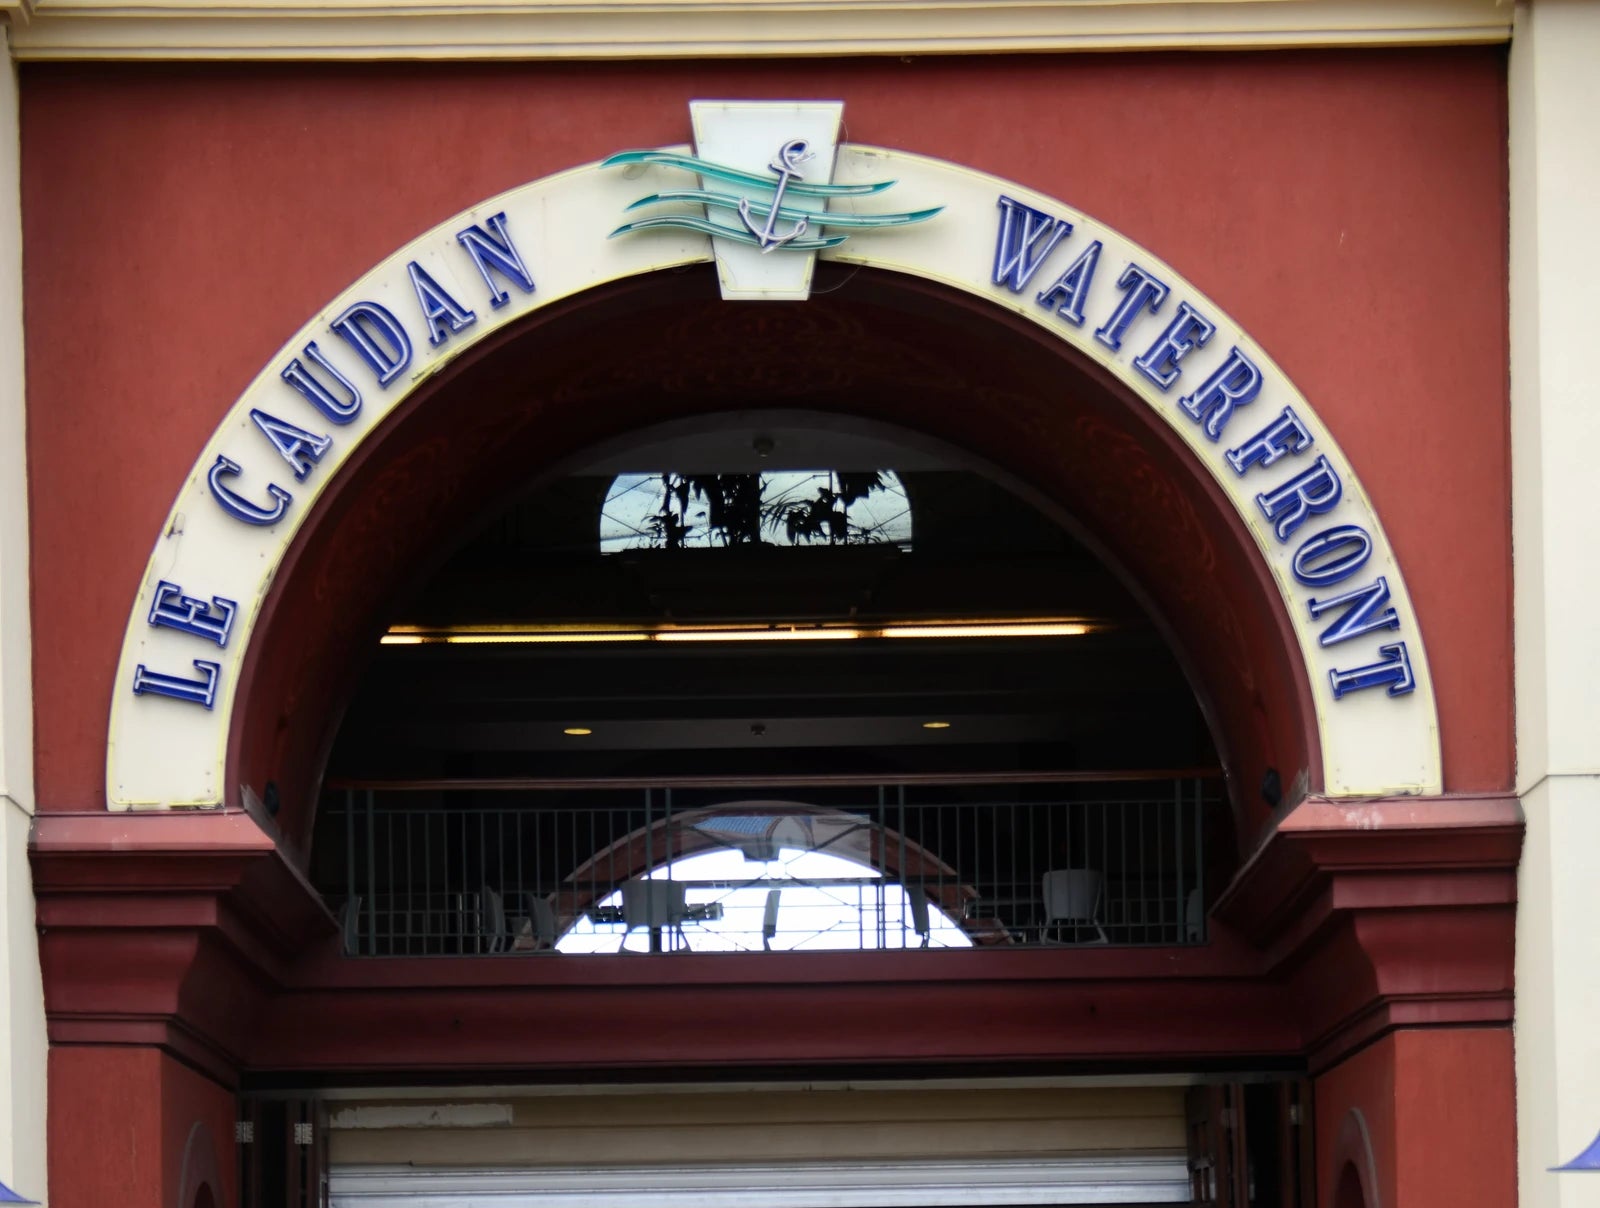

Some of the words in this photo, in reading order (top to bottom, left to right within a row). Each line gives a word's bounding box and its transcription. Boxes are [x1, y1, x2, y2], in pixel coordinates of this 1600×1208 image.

[133, 579, 239, 711] LE
[207, 211, 536, 526] CAUDAN
[991, 195, 1416, 701] WATERFRONT
